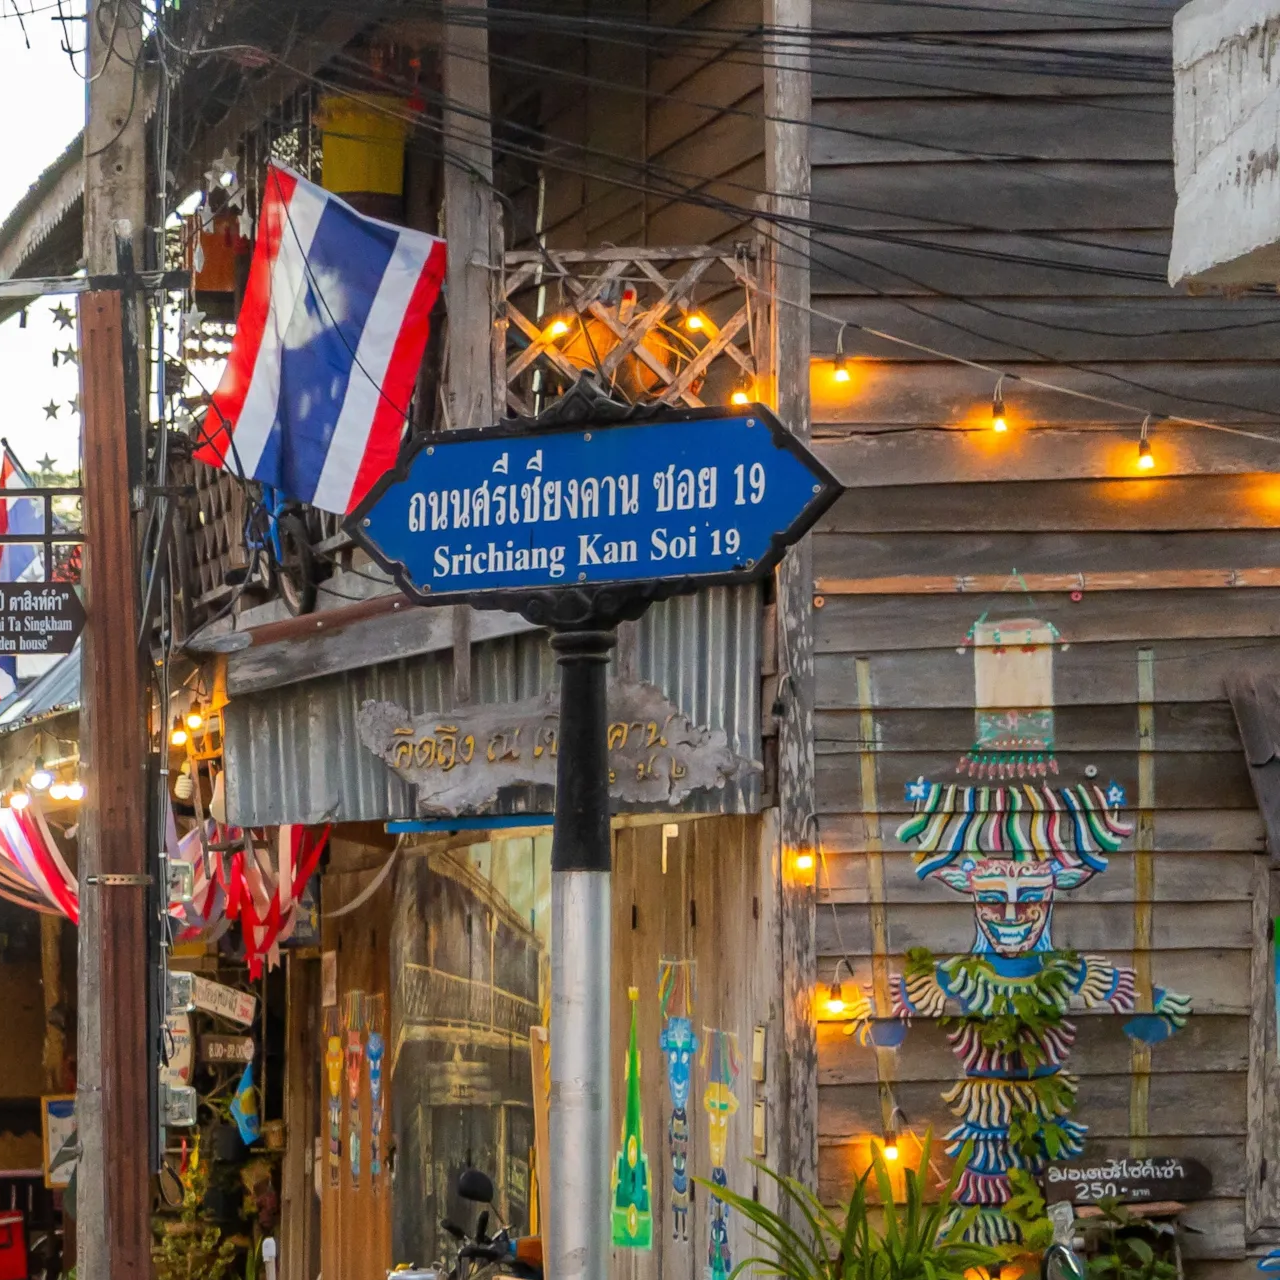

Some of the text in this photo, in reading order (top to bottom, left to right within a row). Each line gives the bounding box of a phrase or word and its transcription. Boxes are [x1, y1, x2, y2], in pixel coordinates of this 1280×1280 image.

[408, 449, 766, 533] ถนนศรีเชียงคาน ซอย 19
[433, 525, 741, 578] Srichiang Kan Soi 19
[8, 616, 21, 632] Ta
[24, 615, 73, 635] Singkham
